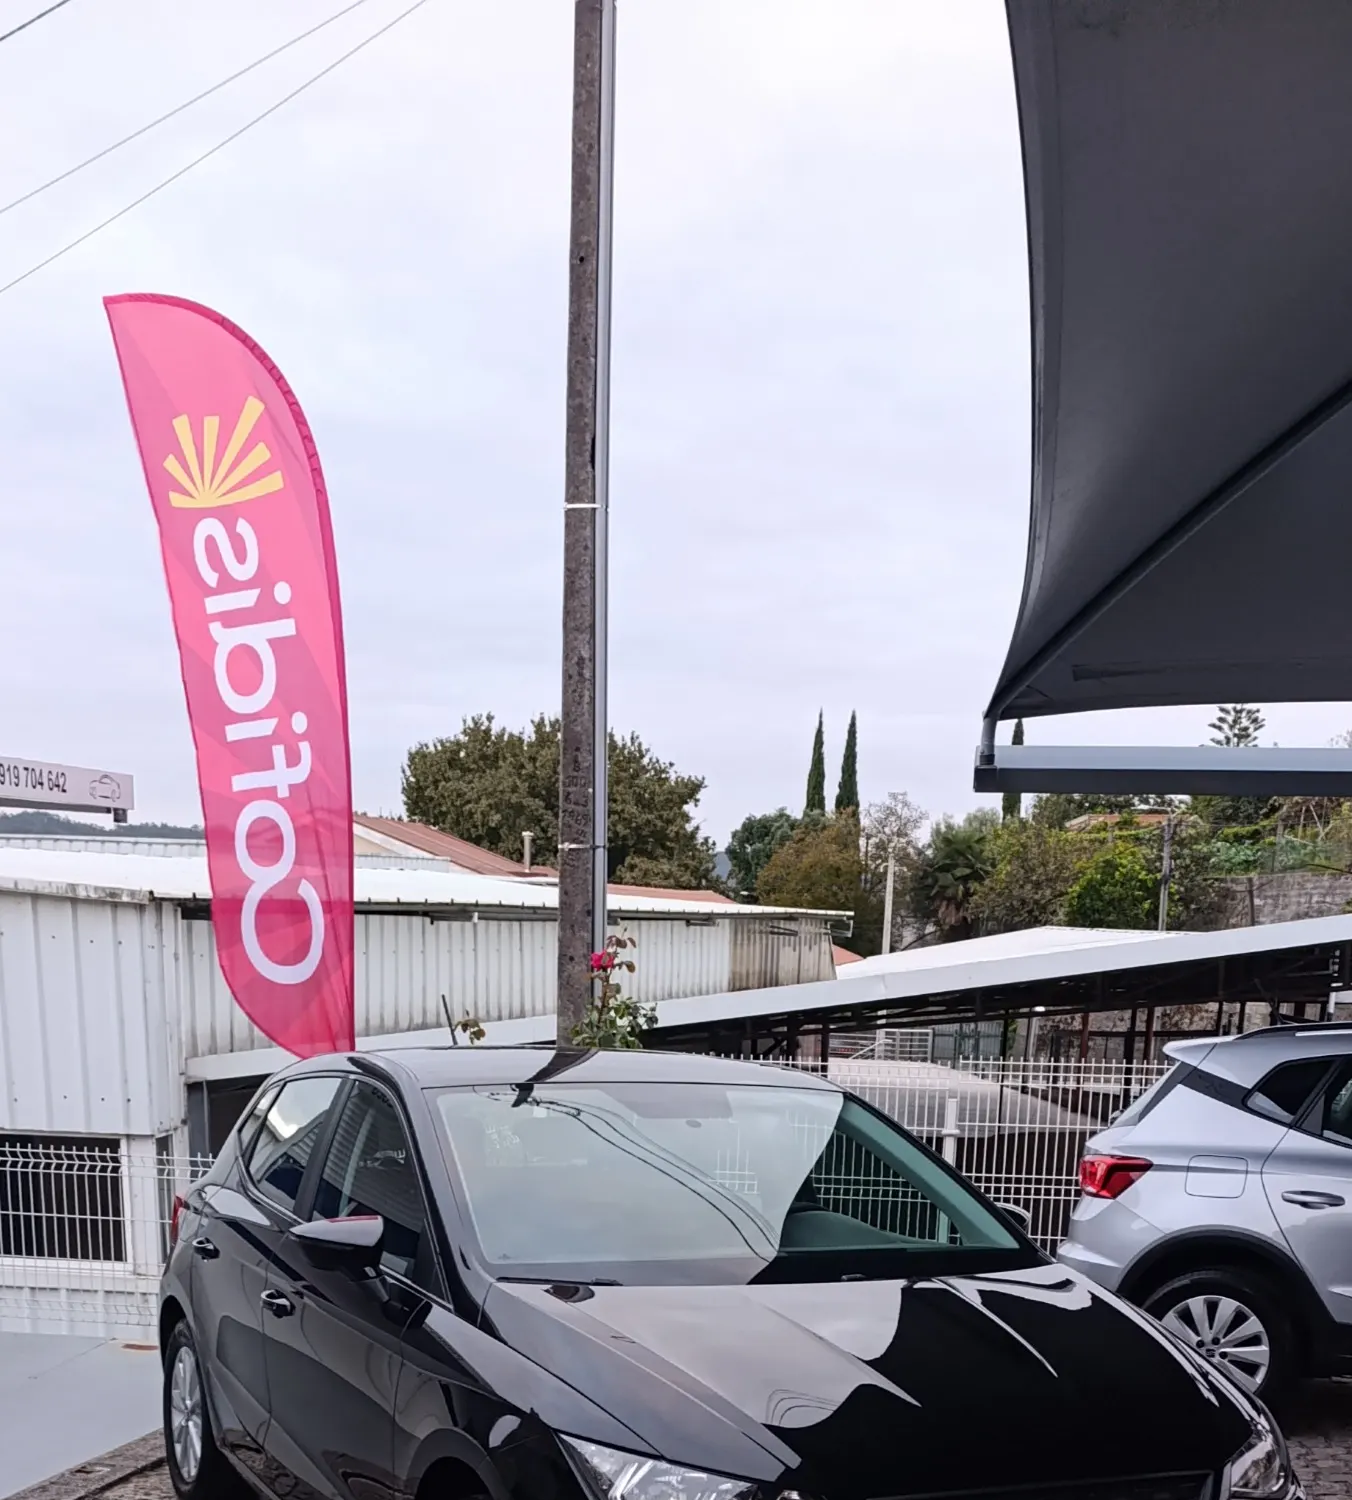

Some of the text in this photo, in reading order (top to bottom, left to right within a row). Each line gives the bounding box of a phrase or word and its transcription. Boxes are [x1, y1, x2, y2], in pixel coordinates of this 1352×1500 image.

[0, 762, 67, 793] 919 704 642
